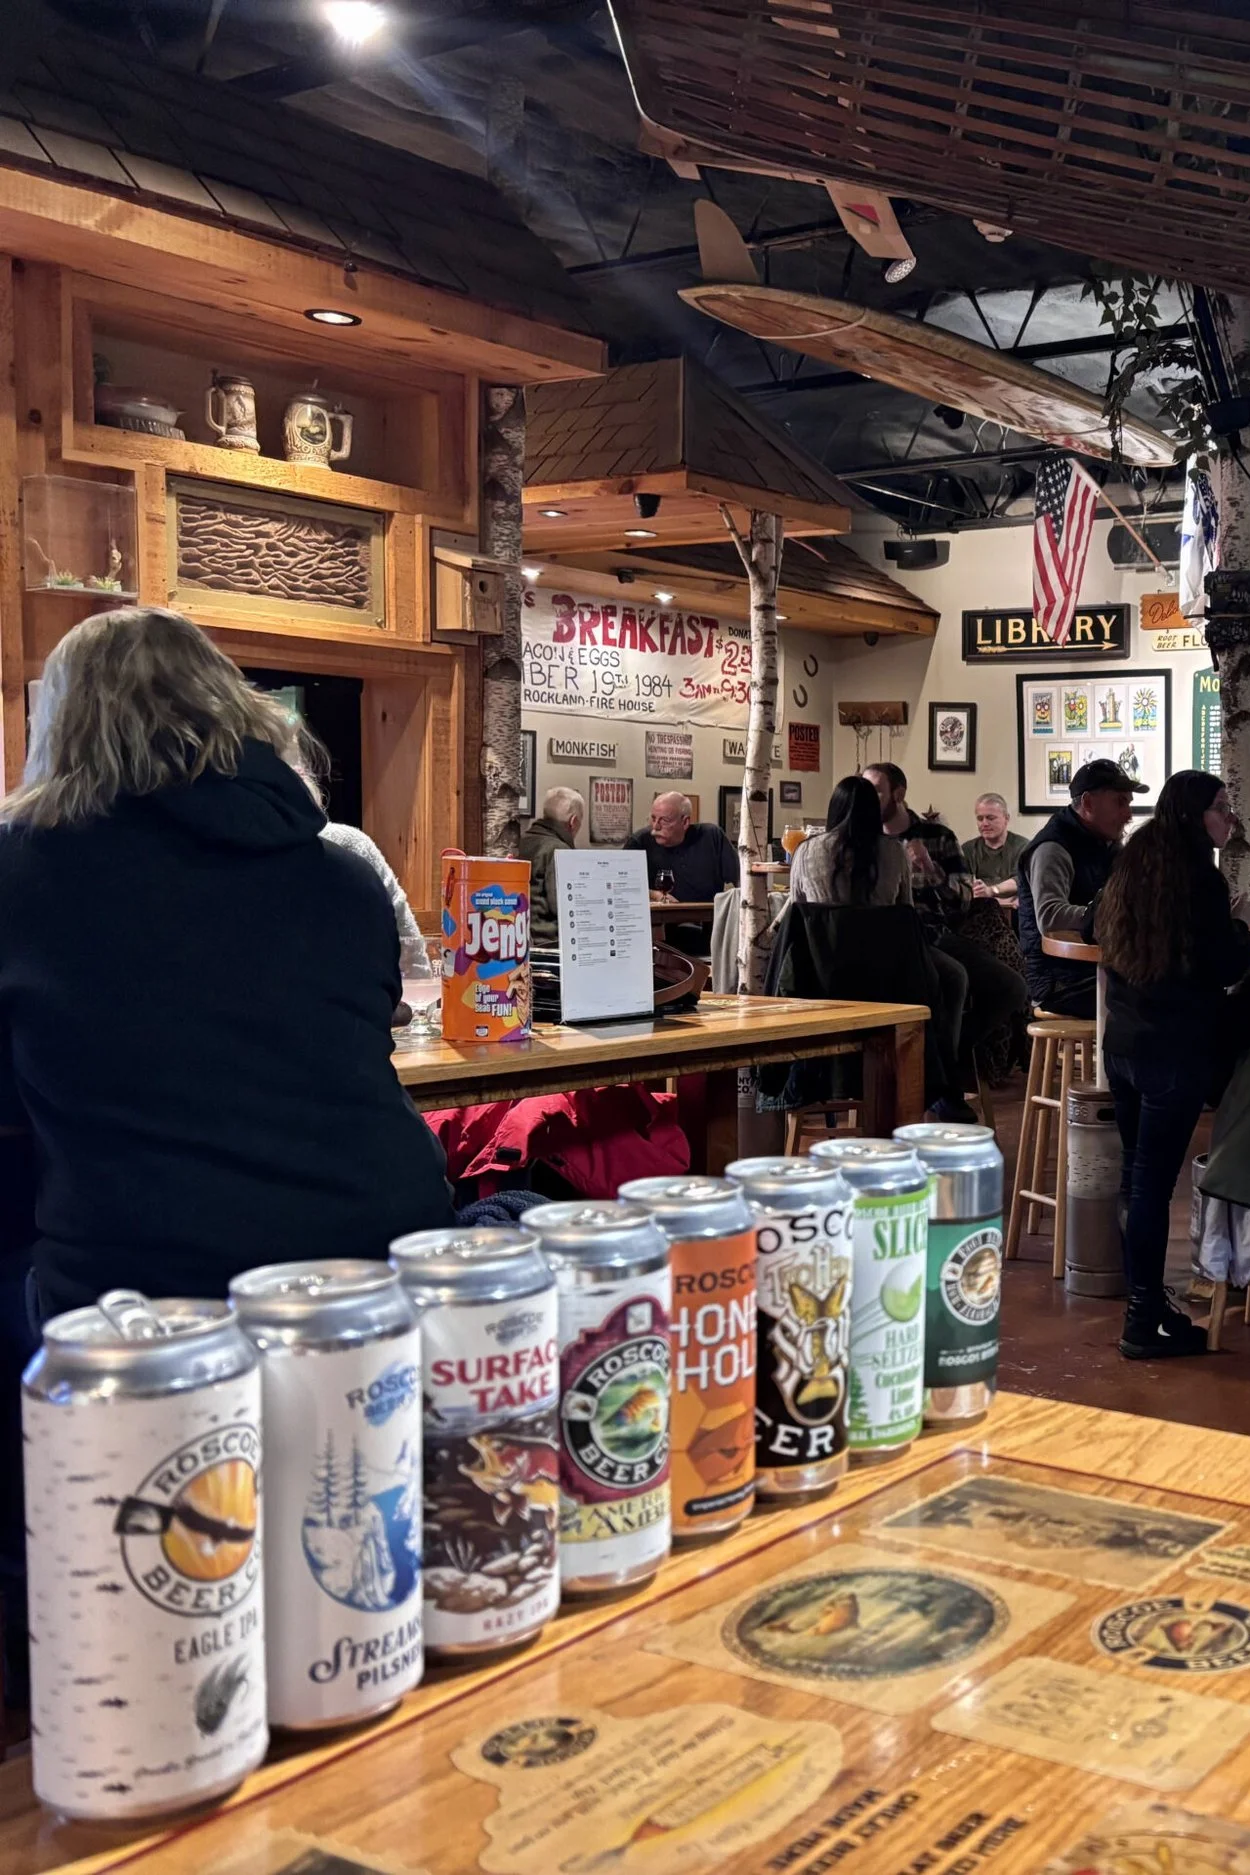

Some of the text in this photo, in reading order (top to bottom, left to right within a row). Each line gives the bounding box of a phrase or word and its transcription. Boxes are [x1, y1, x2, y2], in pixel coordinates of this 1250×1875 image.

[551, 594, 719, 658] BREAKFAST
[1157, 634, 1177, 642] ROOT
[1157, 641, 1177, 649] BEER
[578, 648, 620, 668] EGGS
[521, 660, 579, 690] BER
[635, 674, 673, 698] 1984
[618, 698, 655, 712] HOUSE
[492, 1004, 513, 1017] FUN!
[468, 1371, 553, 1414] TAKE
[578, 1443, 650, 1483] BEER
[142, 1563, 237, 1609] BEER
[173, 1621, 234, 1666] EAGLE
[1101, 1600, 1174, 1650] ROSCOE
